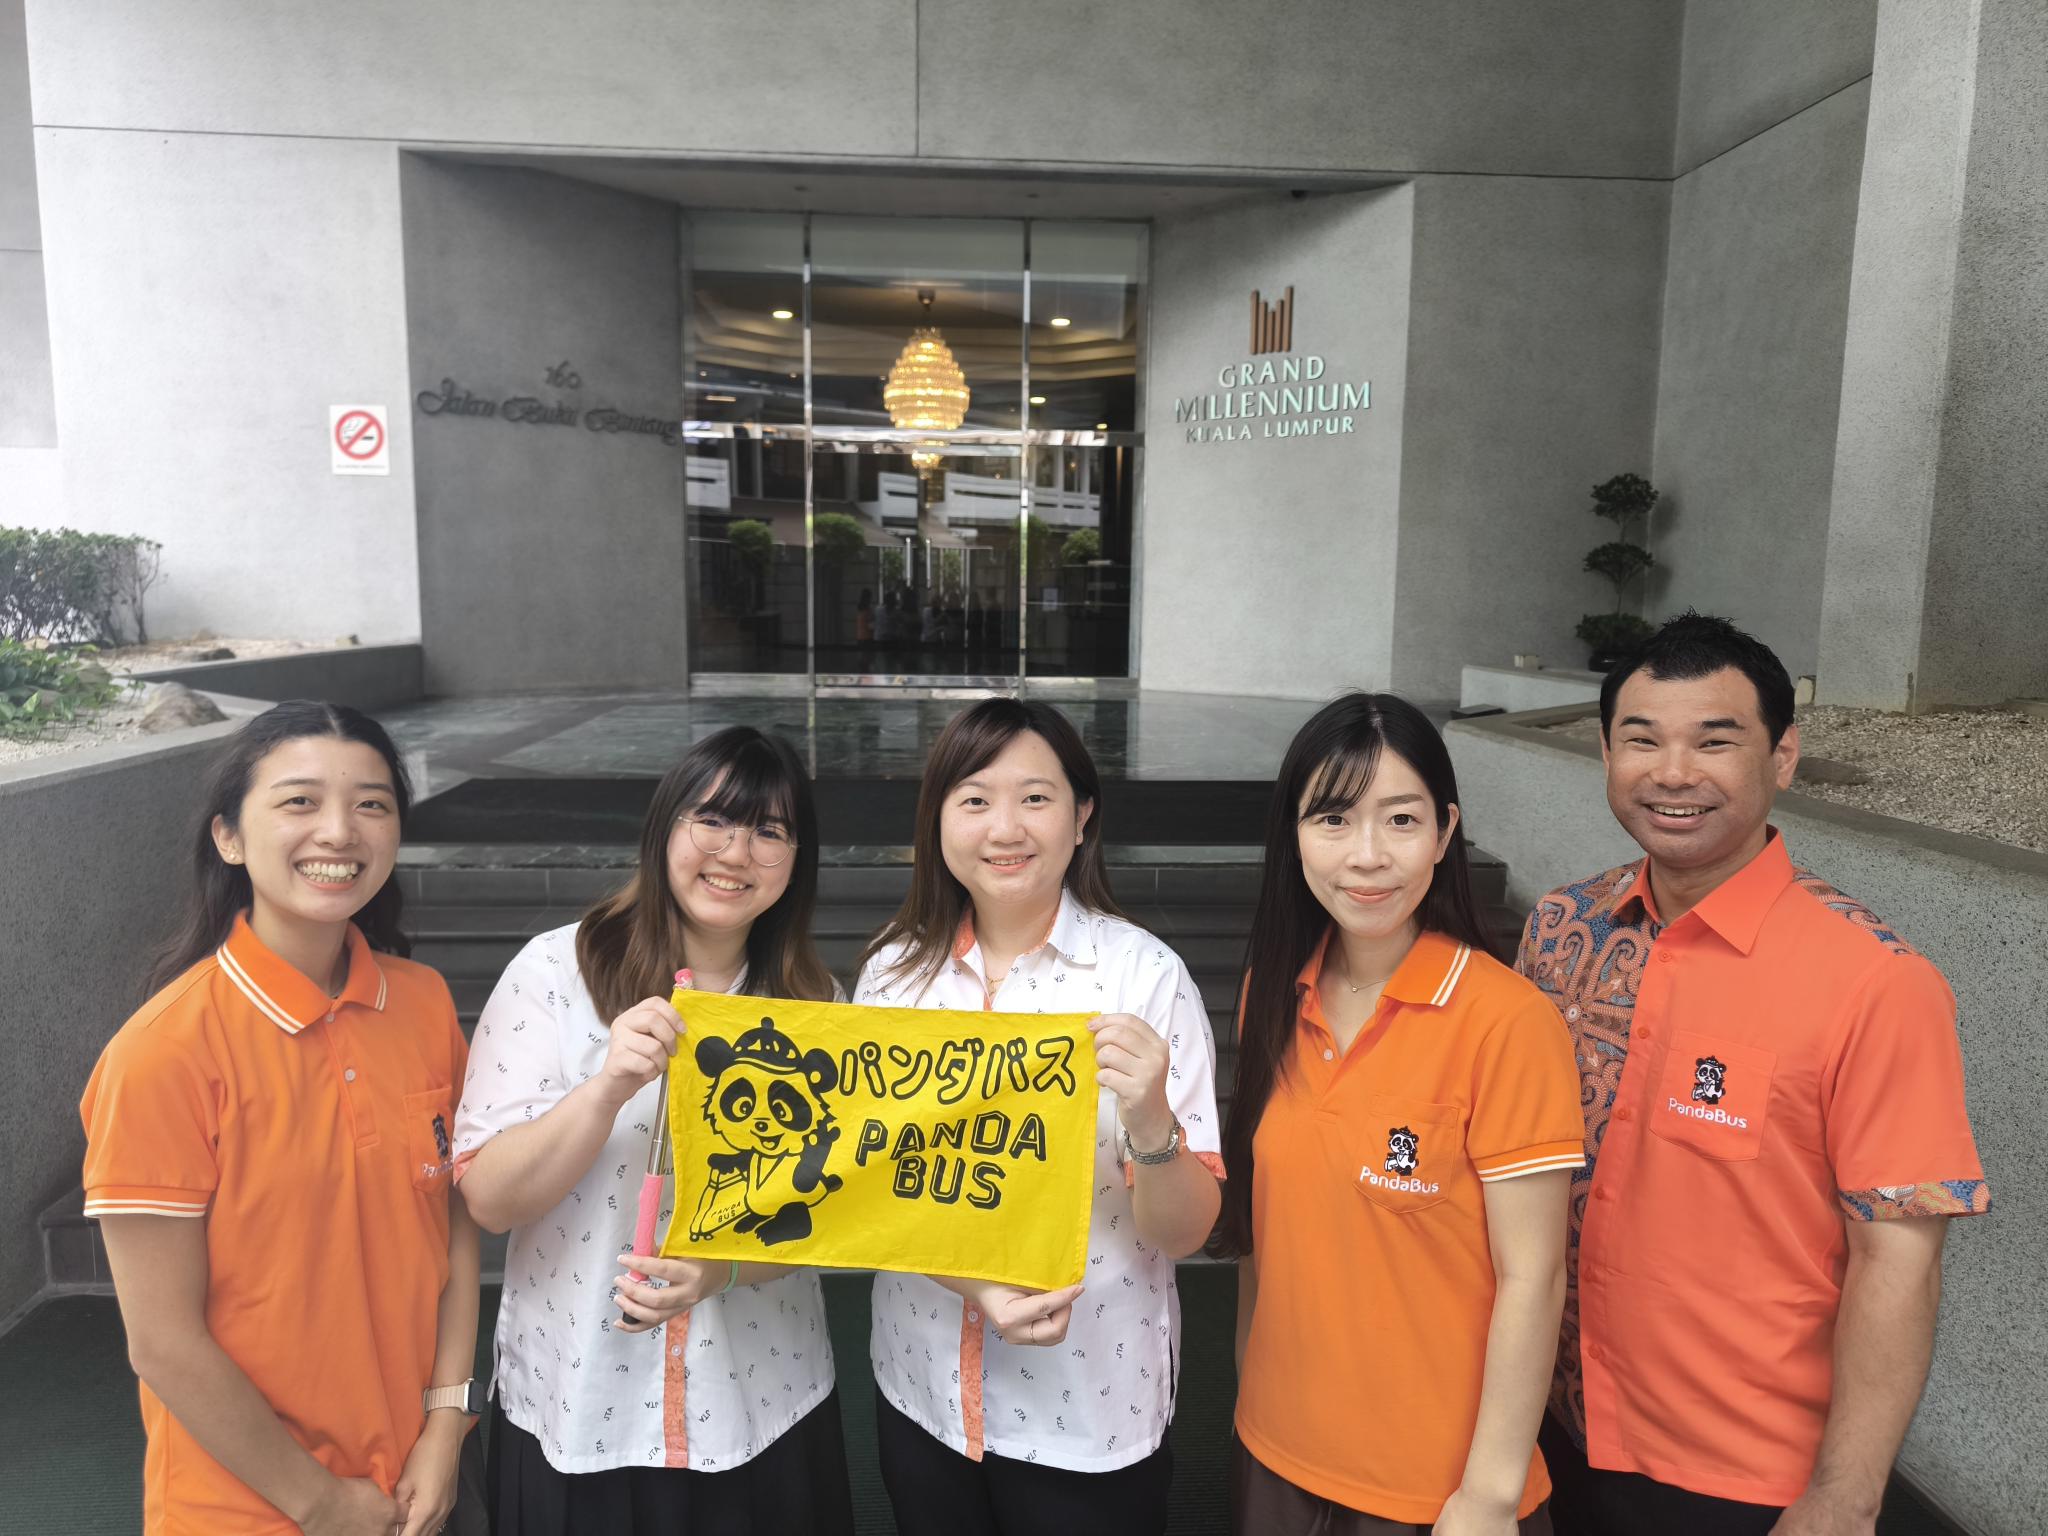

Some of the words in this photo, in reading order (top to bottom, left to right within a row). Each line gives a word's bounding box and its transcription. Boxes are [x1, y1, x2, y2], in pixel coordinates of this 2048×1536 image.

[544, 360, 582, 389] 160
[1218, 356, 1325, 388] GRAND
[1175, 381, 1371, 423] MILLENNIUM
[1186, 425, 1252, 444] KUALA
[1264, 416, 1354, 438] LUMPUR
[1028, 978, 1036, 990] JTA
[1054, 974, 1066, 983] JTA
[559, 994, 570, 1008] JTA
[1175, 992, 1186, 1000] JTA
[513, 1021, 526, 1032] JTA
[588, 1032, 602, 1044] JTA
[1171, 1034, 1179, 1048] JTA
[838, 1035, 1076, 1106] パンダバス
[1171, 1065, 1180, 1080] JTA
[539, 1078, 550, 1092] JTA
[1188, 1112, 1202, 1123] JTA
[1668, 1097, 1748, 1129] PandaBus
[634, 1123, 648, 1134] JTA
[855, 1110, 1047, 1167] PANDA
[616, 1164, 627, 1179] JTA
[893, 1154, 1007, 1210] BUS
[1360, 1165, 1439, 1194] PandaBus
[1099, 1185, 1112, 1195] JTA
[608, 1195, 617, 1210] JTA
[659, 1210, 672, 1221] JTA
[1110, 1215, 1119, 1230] JTA
[1091, 1256, 1103, 1265] JTA
[573, 1272, 582, 1285] JTA
[1123, 1276, 1133, 1287] JTA
[1095, 1303, 1105, 1318] JTA
[601, 1318, 609, 1332] JTA
[1141, 1318, 1150, 1327] JTA
[536, 1327, 545, 1337] JTA
[651, 1326, 662, 1339] JTA
[991, 1329, 1003, 1341] JTA
[700, 1339, 713, 1347] JTA
[1072, 1349, 1086, 1359] JTA
[1116, 1342, 1124, 1358] JTA
[572, 1358, 580, 1368] JTA
[616, 1364, 628, 1373] JTA
[534, 1366, 543, 1381] JTA
[951, 1370, 959, 1383] JTA
[1020, 1367, 1034, 1381] JTA
[1140, 1366, 1150, 1379] JTA
[1063, 1389, 1071, 1403] JTA
[1100, 1385, 1110, 1397] JTA
[562, 1398, 570, 1414] JTA
[898, 1399, 907, 1411] JTA
[948, 1399, 956, 1413] JTA
[1130, 1403, 1142, 1416] JTA
[604, 1406, 614, 1421] JTA
[699, 1410, 711, 1423] JTA
[1014, 1408, 1026, 1422] JTA
[1056, 1416, 1065, 1430] JTA
[596, 1439, 604, 1454] JTA
[1107, 1435, 1117, 1450] JTA
[648, 1447, 660, 1460] JTA
[1024, 1449, 1036, 1461] JTA
[702, 1458, 716, 1466] JTA
